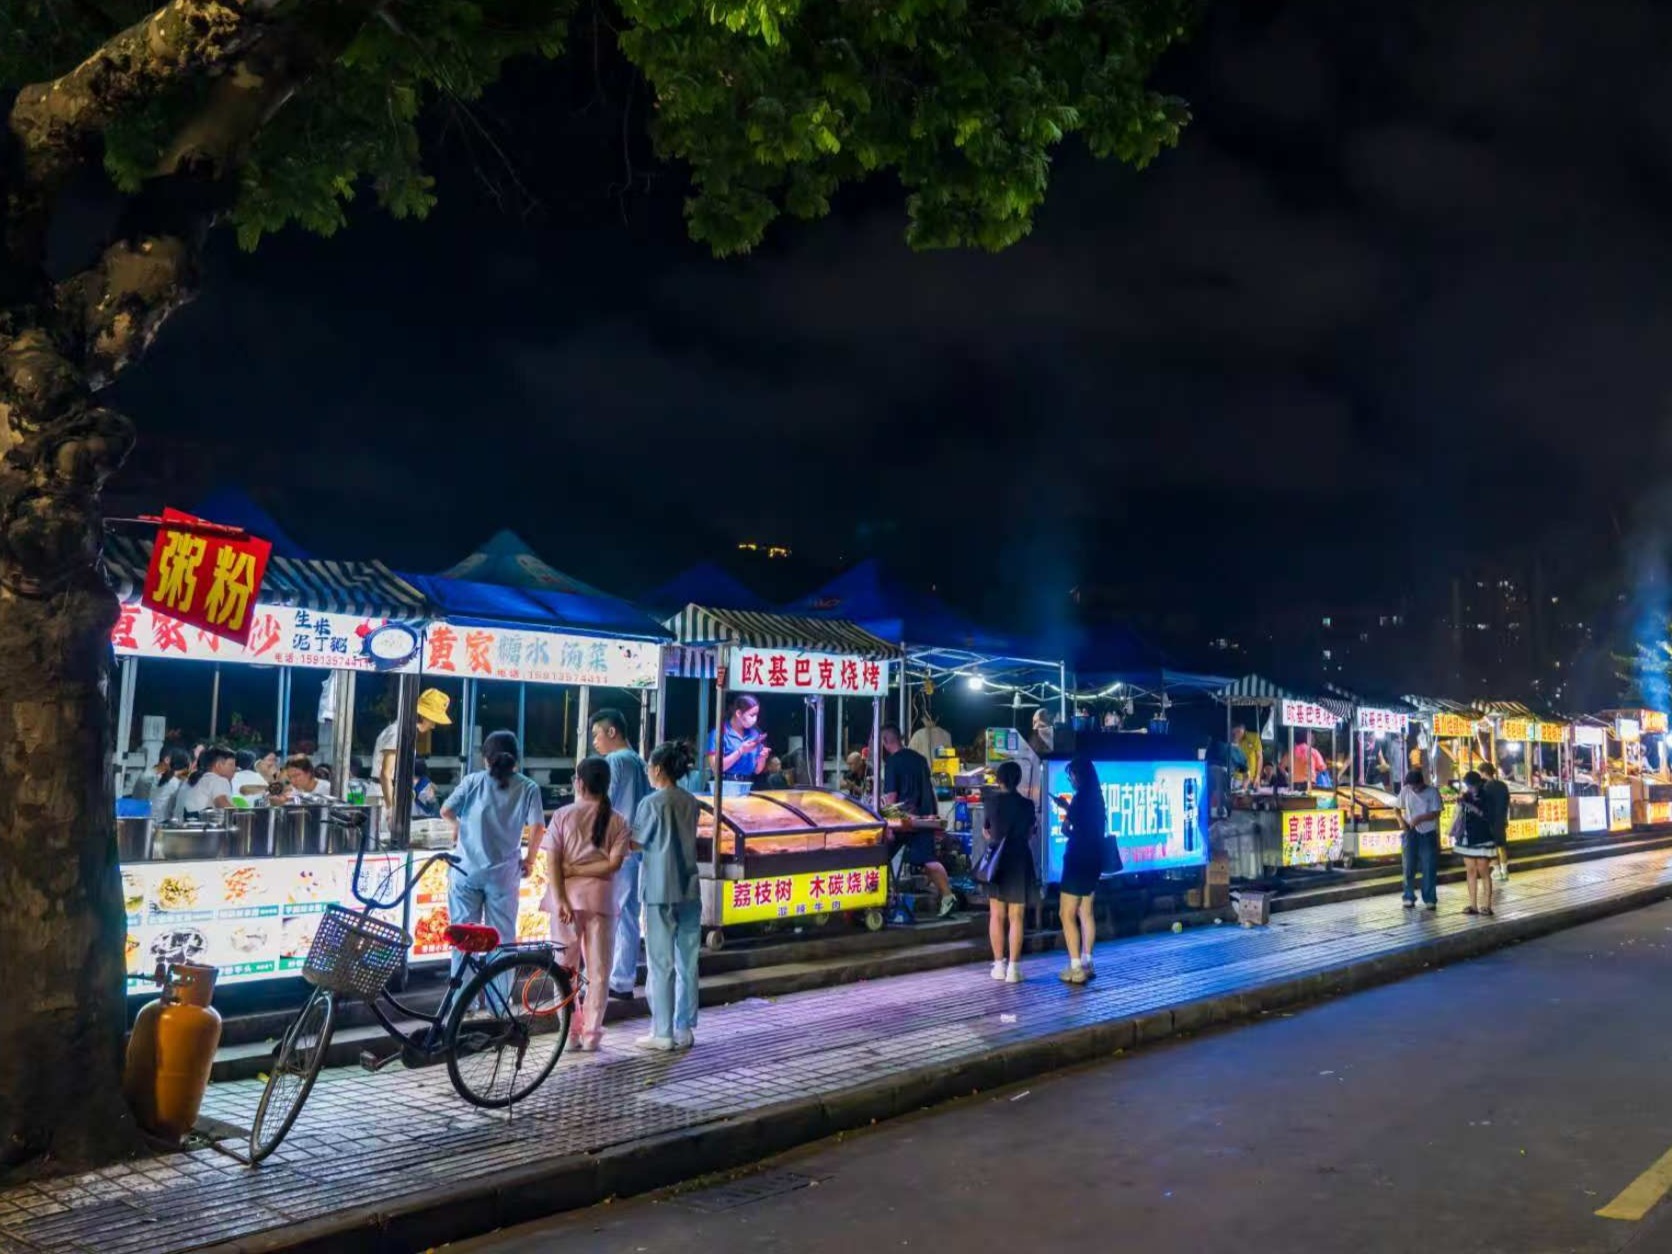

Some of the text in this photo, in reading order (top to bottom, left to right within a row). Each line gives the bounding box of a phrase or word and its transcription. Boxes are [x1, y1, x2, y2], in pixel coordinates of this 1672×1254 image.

[152, 531, 257, 632] 粥粉
[741, 653, 880, 691] 欧基巴克烧烤
[733, 878, 792, 908] 荔枝树
